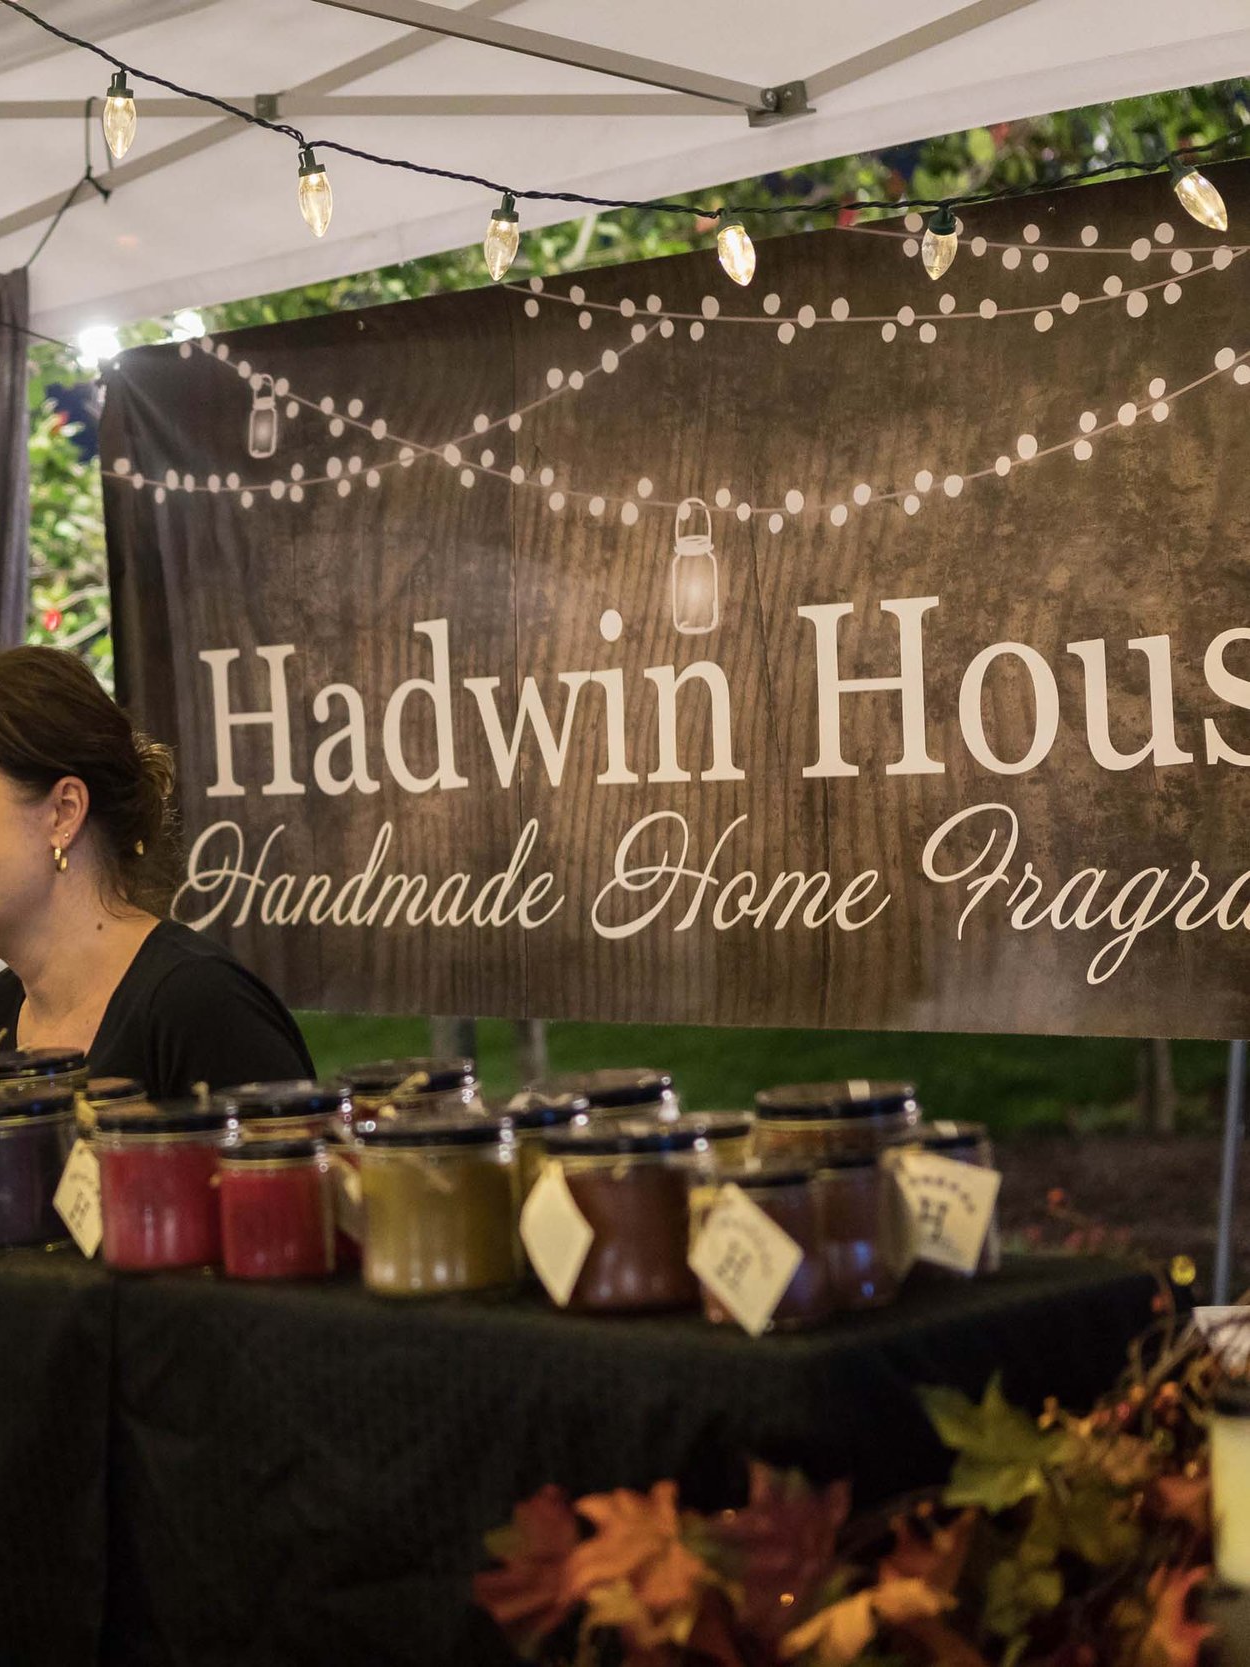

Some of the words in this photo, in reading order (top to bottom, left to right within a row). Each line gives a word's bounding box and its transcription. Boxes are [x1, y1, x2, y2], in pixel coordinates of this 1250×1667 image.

[199, 609, 745, 797] Hadwin
[797, 596, 1250, 778] Hous
[171, 818, 564, 932] Handmade
[591, 811, 891, 939] Home
